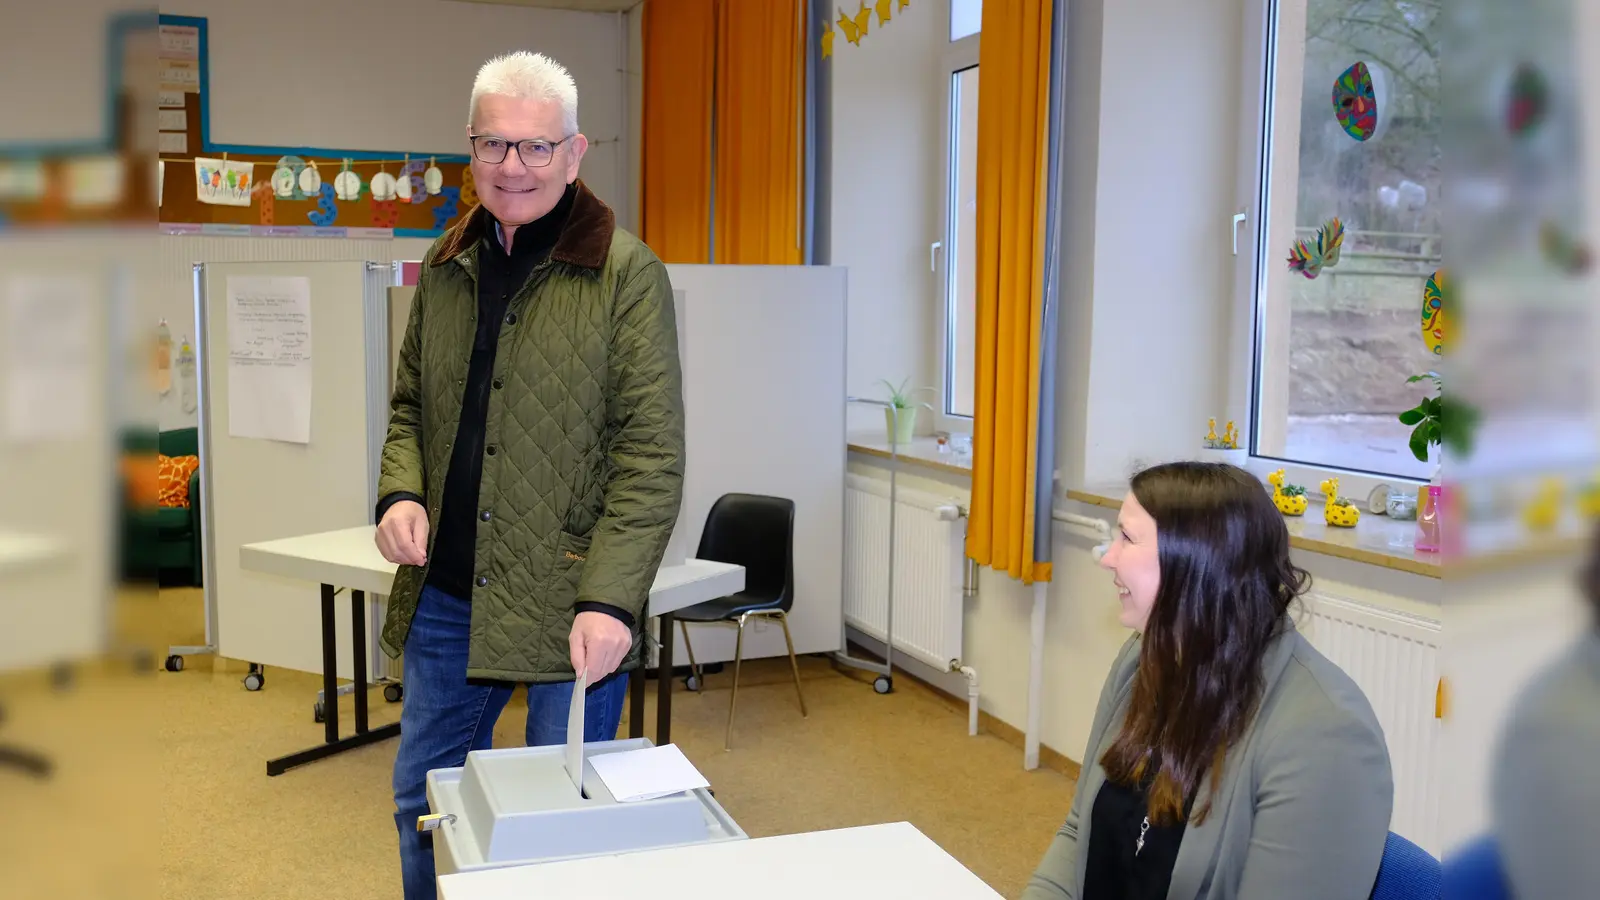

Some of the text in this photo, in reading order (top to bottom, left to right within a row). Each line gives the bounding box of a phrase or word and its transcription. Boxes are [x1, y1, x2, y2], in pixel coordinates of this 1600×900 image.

[251, 180, 273, 225] 1
[307, 182, 338, 226] 3
[431, 186, 460, 230] 7
